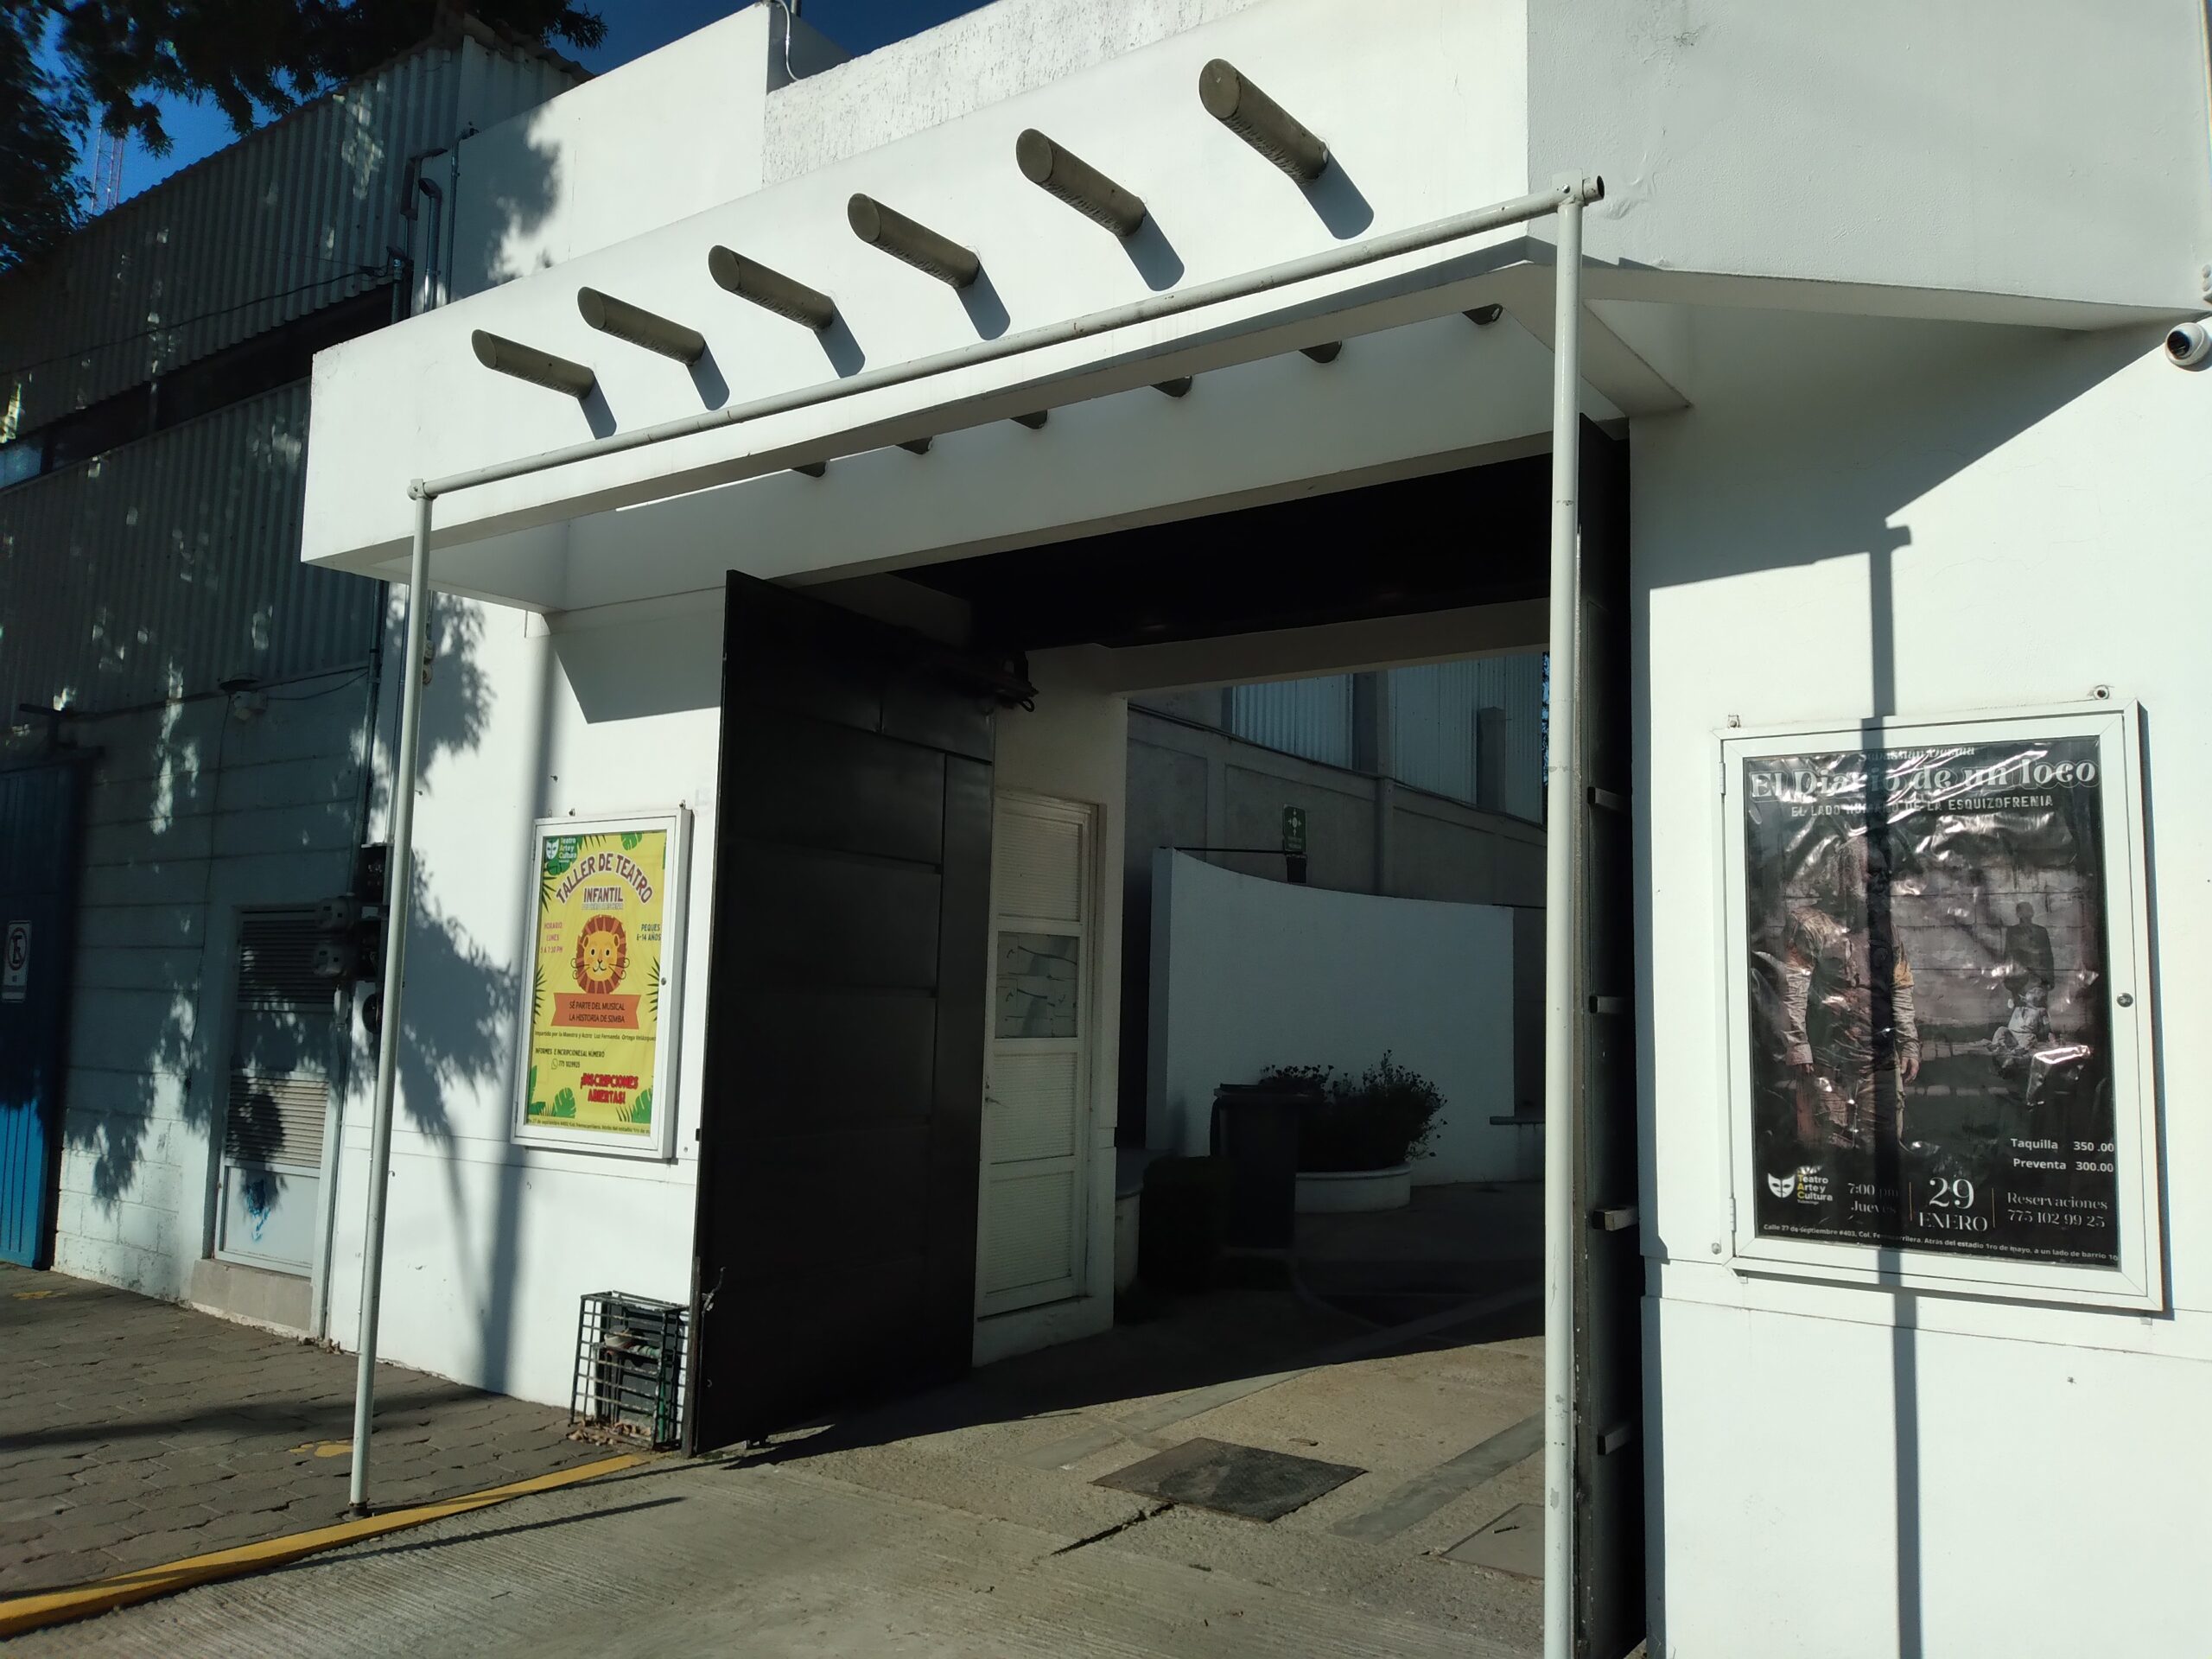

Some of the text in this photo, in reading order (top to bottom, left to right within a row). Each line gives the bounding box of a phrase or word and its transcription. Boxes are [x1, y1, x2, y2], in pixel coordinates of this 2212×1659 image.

[1751, 772, 1783, 798] El
[1912, 766, 1952, 791] de
[1964, 767, 2008, 787] un
[2021, 758, 2096, 785] loco
[1791, 805, 1806, 817] EL
[1811, 804, 1840, 817] LADO
[1927, 800, 1943, 812] LA
[1948, 794, 2054, 811] ESQUIZOFRENIA
[556, 853, 653, 905] TALLER DE TEATRO
[583, 887, 624, 903] INFANTIL
[640, 923, 661, 932] PEQUES
[569, 1001, 575, 1009] SÉ
[575, 1001, 591, 1010] PARTE
[602, 1002, 626, 1011] MUSICAL
[587, 1089, 626, 1104] ABIERTAS!
[2010, 1138, 2059, 1151] Taquilla
[2073, 1141, 2094, 1152] 350
[2013, 1158, 2114, 1173] Preventa 300.00
[1797, 1174, 1829, 1185] Teatro
[1797, 1192, 1834, 1202] Cultura
[1847, 1182, 1876, 1196] 7:00
[1929, 1177, 1975, 1210] 29
[2006, 1192, 2108, 1211] Reservaciones
[1918, 1211, 1988, 1232] ENERO
[2007, 1209, 2107, 1229] 775 102 99 25
[1858, 1230, 1872, 1239] Col.
[1956, 1240, 1985, 1249] estadio
[1986, 1243, 1999, 1251] 1ro
[2081, 1250, 2107, 1260] barrio
